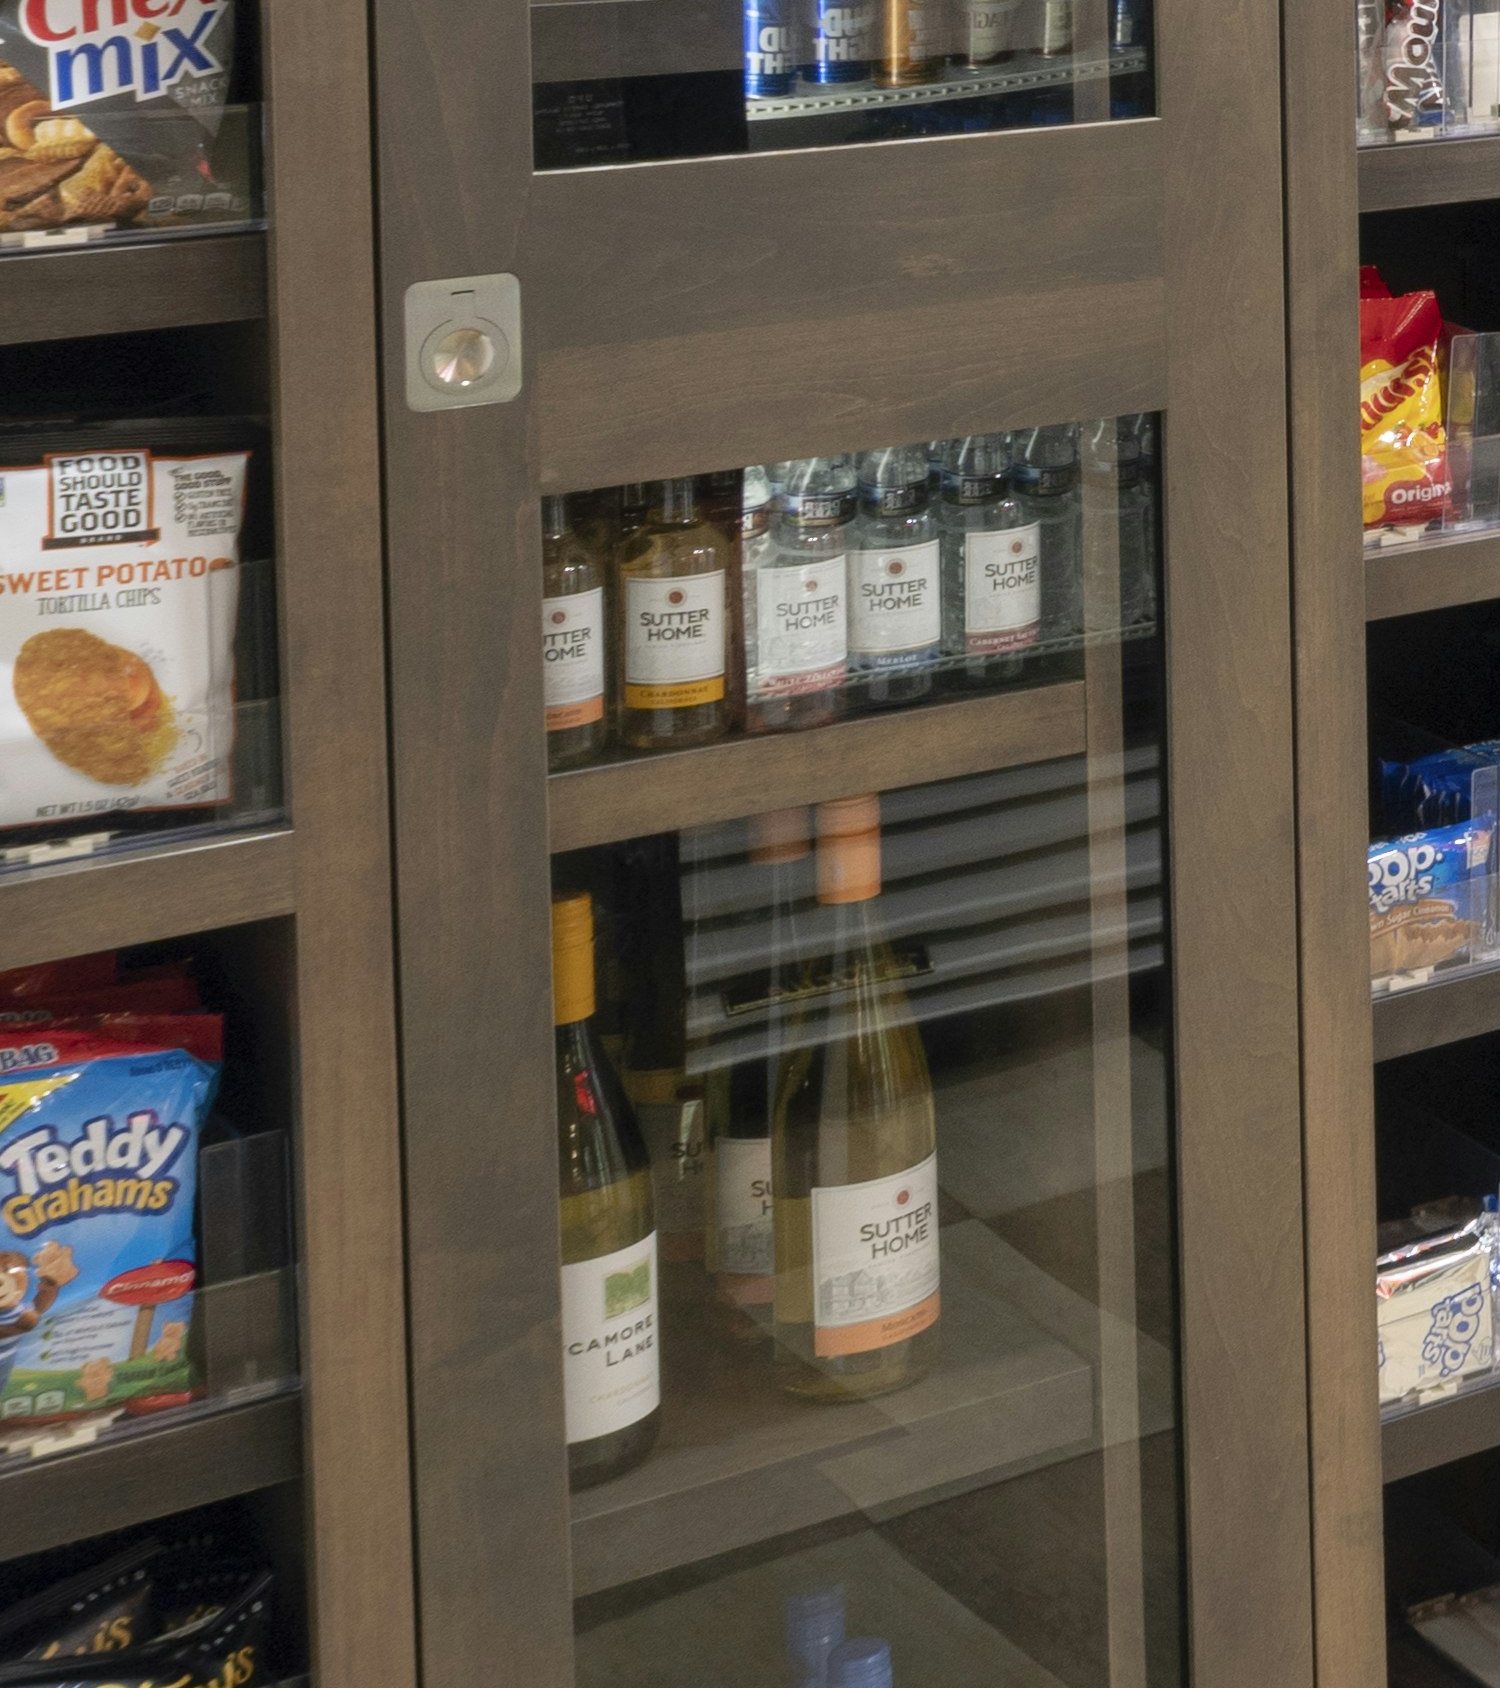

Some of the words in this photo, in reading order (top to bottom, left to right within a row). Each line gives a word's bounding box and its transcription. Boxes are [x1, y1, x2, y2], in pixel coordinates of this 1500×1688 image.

[58, 455, 141, 475] FOOD
[60, 472, 141, 491] SHOULD
[60, 490, 141, 512] TASTE
[60, 509, 141, 533] GOOD
[97, 556, 207, 586] POTATO
[984, 555, 1039, 578] SUTTER
[861, 576, 927, 598] SUTTER
[992, 570, 1035, 591] HOME
[36, 591, 112, 616] TORTILLA
[116, 587, 161, 608] CHIPS
[776, 594, 839, 618] SUTTER
[868, 591, 923, 611] HOME
[640, 608, 709, 626] SUTTER
[785, 611, 835, 632] HOME
[647, 624, 703, 642] HOME
[0, 1044, 58, 1070] BAG
[2, 1115, 189, 1194] Teddy
[2, 1176, 176, 1237] Grahams
[859, 1201, 932, 1243] SUTTER
[870, 1224, 929, 1259] HOME
[106, 1269, 196, 1298] Cinnamo
[605, 1335, 654, 1368] LANE
